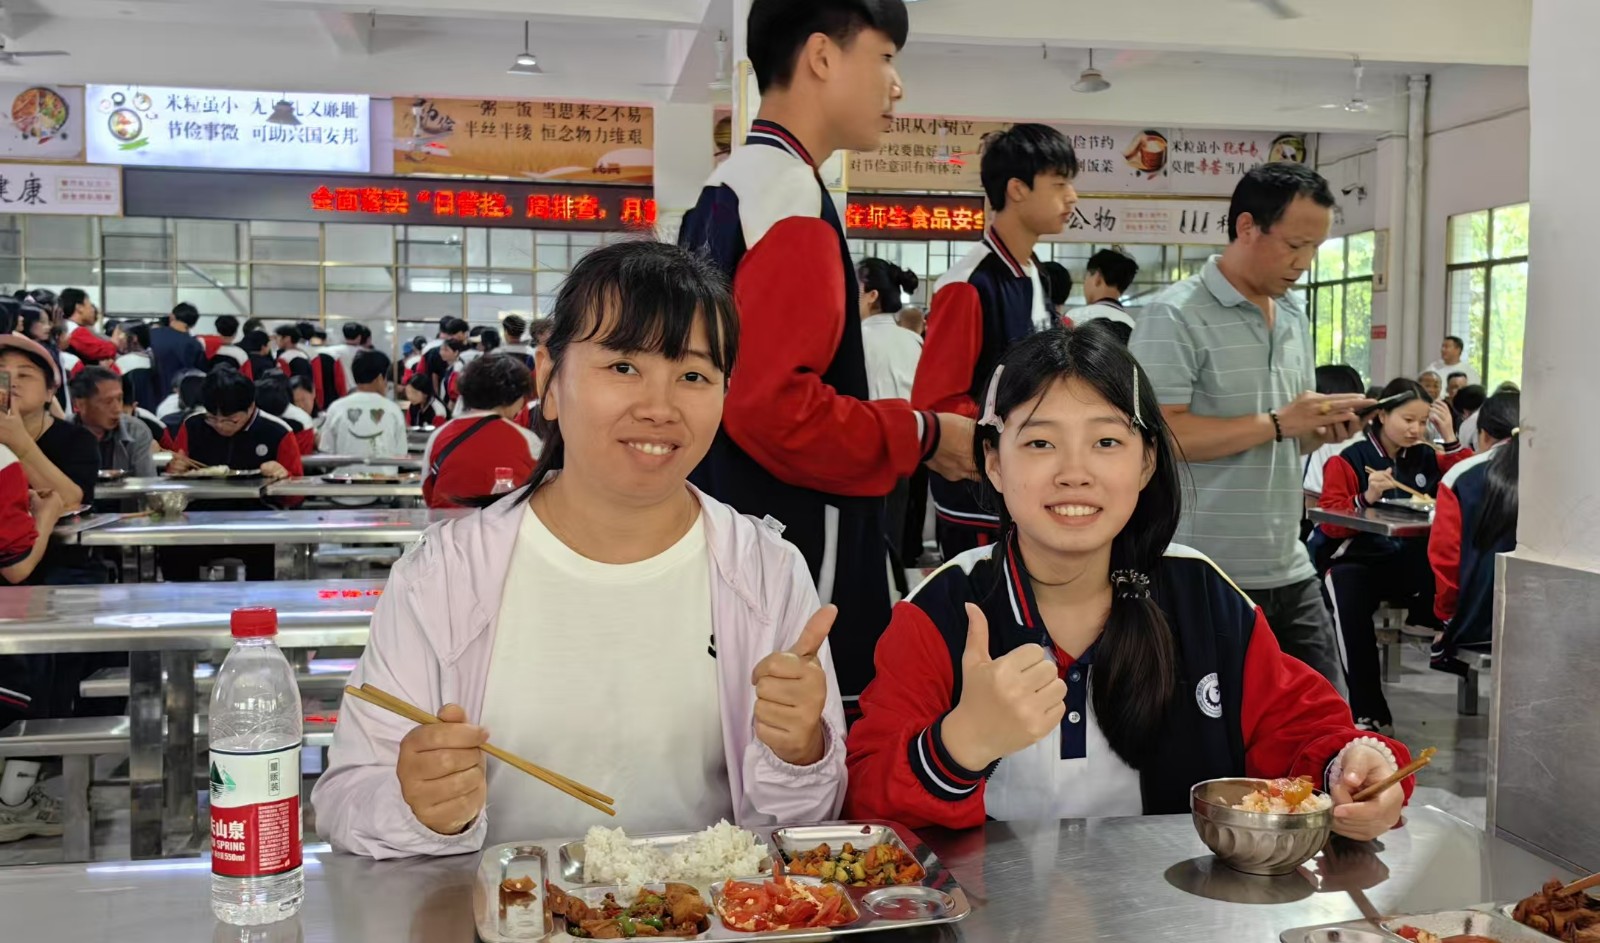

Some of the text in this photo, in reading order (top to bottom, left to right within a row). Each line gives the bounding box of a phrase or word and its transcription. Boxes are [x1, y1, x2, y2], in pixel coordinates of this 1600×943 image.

[166, 94, 359, 119] 米粒虽小 无礼义廉耻
[461, 100, 642, 123] 一粥一饭 当思来之不易
[168, 121, 359, 145] 节俭事微 可助兴国安邦
[464, 120, 642, 145] 半丝半缕 恒念物力维艰
[882, 117, 974, 136] 识从小树立
[1068, 135, 1114, 150] 俭节约
[1069, 206, 1116, 232] 公物
[216, 840, 245, 851] SPRING
